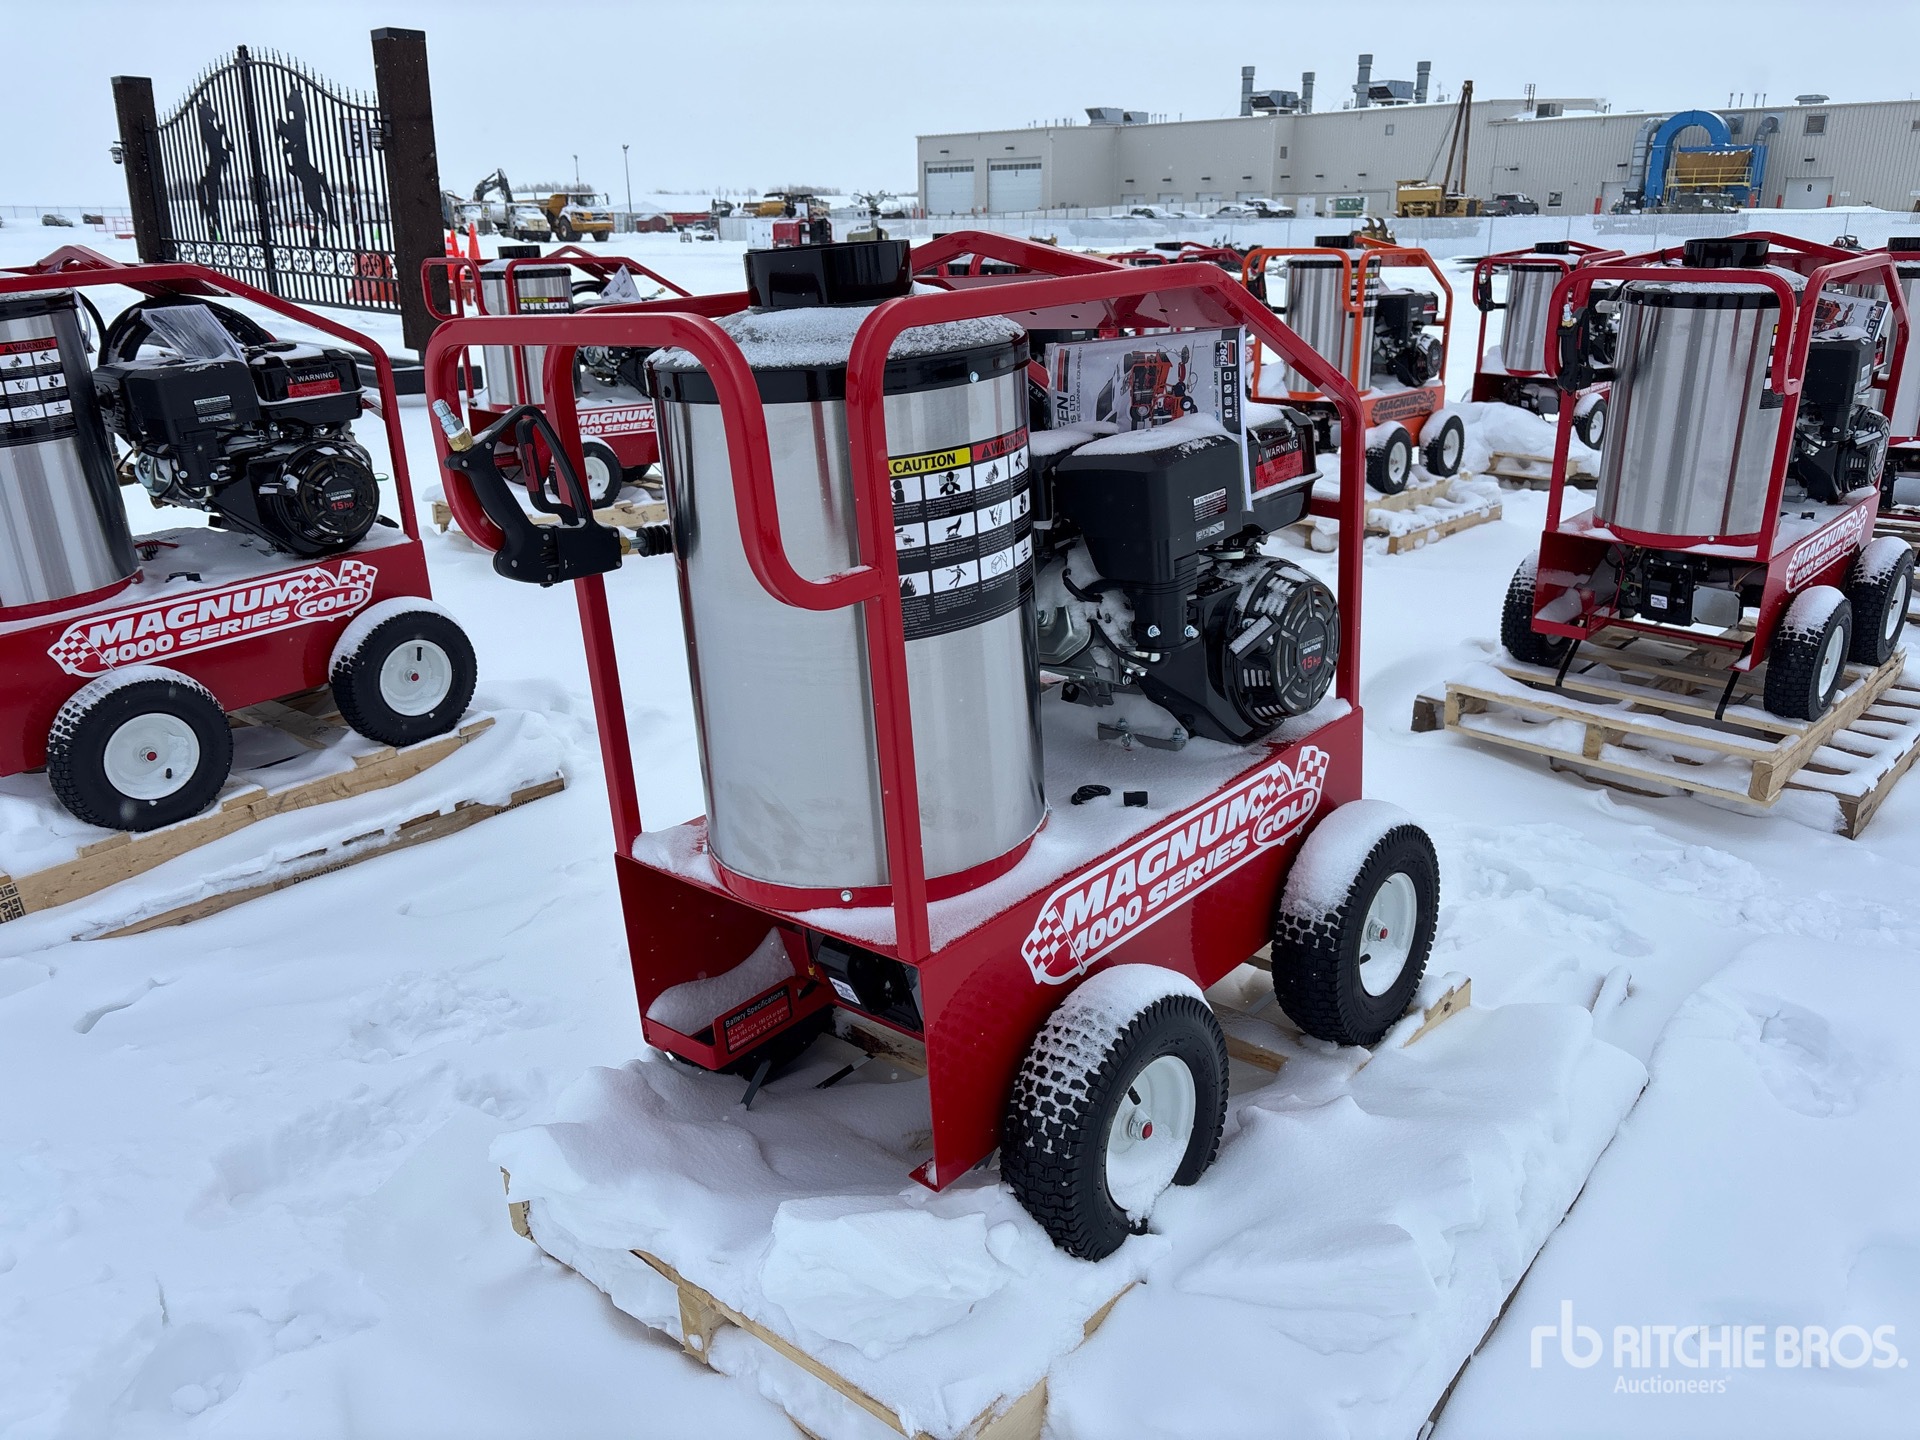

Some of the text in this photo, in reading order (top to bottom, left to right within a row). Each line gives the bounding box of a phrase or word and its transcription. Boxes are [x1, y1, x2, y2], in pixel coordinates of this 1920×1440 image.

[1806, 183, 1813, 193] 8
[12, 340, 52, 352] WARNING
[1220, 341, 1228, 366] 1982
[297, 372, 335, 382] WARNING
[1379, 395, 1422, 411] MAGNUM
[578, 409, 653, 426] MAGNUM
[578, 421, 650, 435] 000 SERIES
[991, 431, 1025, 454] WARNING
[1265, 440, 1299, 458] WARNING
[893, 452, 956, 474] CAUTION
[1797, 521, 1850, 567] MAGNUM
[89, 578, 301, 647] MAGNUM
[301, 590, 364, 616] GOLD
[100, 606, 289, 665] 4000 SERIES
[1257, 789, 1314, 841] GOLD
[1062, 792, 1262, 932] MAGNUM
[1070, 829, 1248, 959] 4000 SERIES
[725, 1012, 746, 1028] Battery
[727, 1029, 734, 1037] 12
